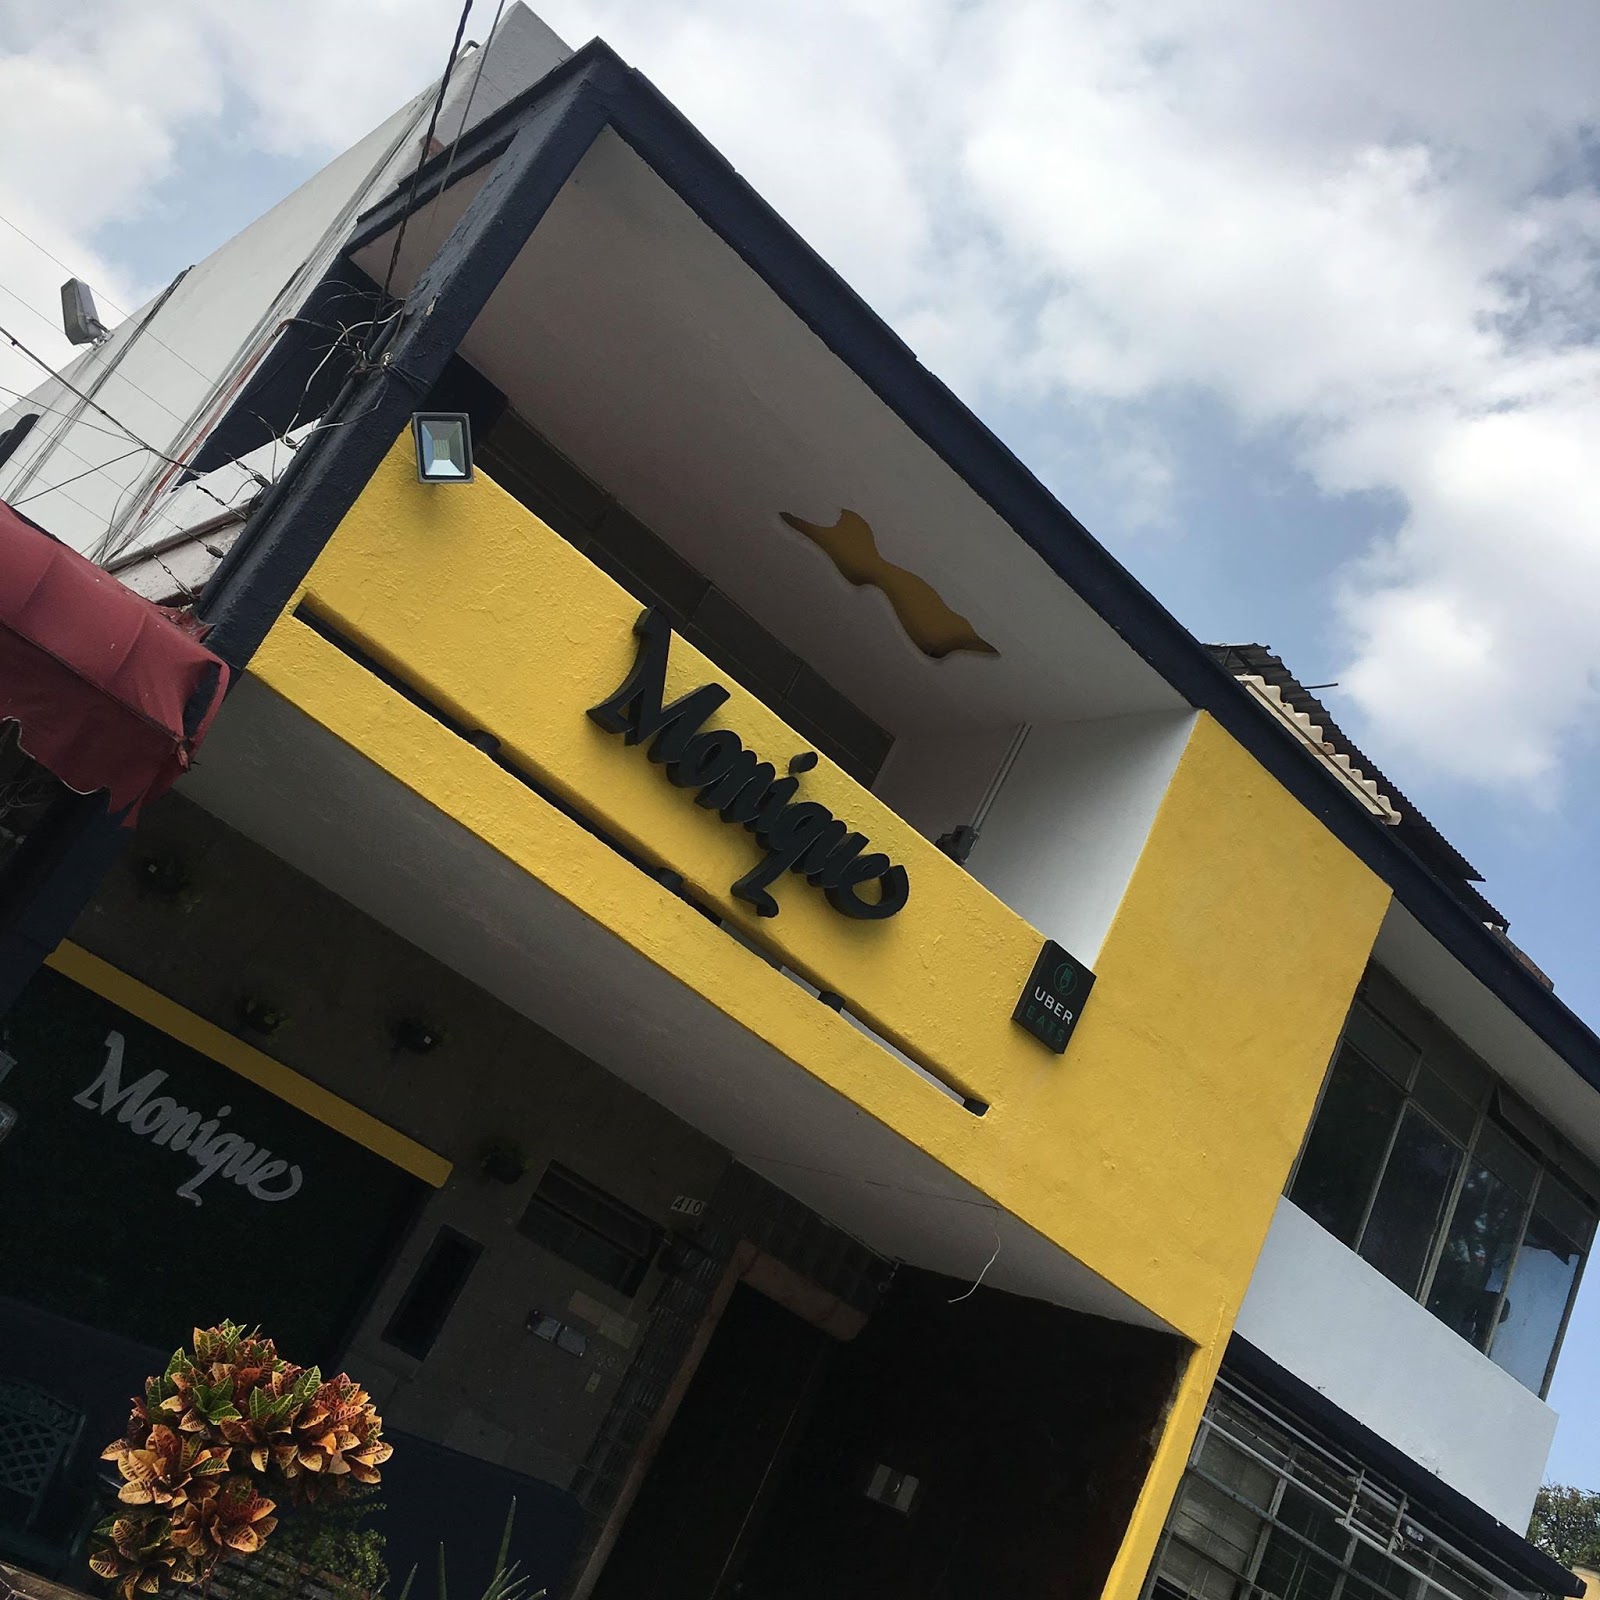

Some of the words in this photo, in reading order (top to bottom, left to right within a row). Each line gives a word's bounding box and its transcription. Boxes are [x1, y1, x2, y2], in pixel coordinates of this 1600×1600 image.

[586, 605, 909, 919] Monique
[1026, 1005, 1065, 1042] EATS
[1034, 986, 1073, 1025] UBER
[73, 1030, 303, 1207] Monique
[673, 1198, 702, 1214] 410
